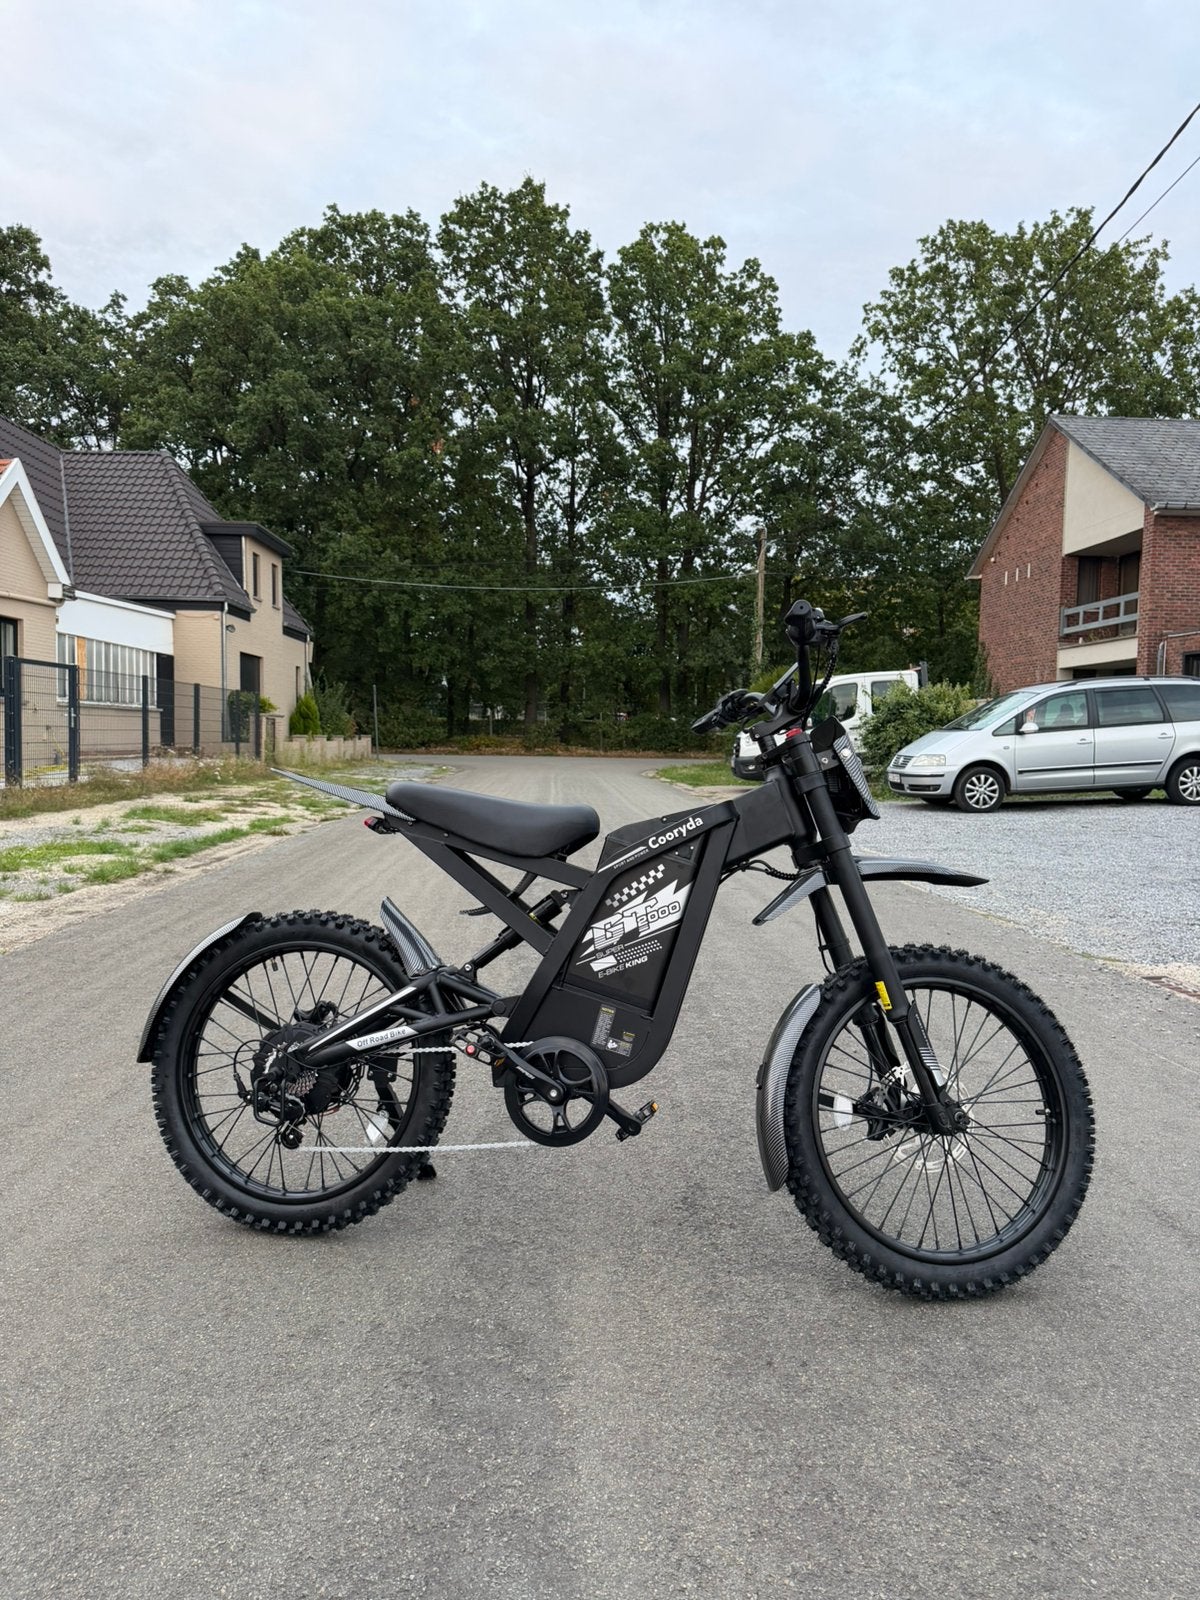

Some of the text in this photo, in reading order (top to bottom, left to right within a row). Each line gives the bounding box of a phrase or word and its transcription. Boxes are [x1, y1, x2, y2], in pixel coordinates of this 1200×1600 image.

[648, 817, 704, 849] Cooryda
[596, 944, 625, 959] SUPER
[598, 955, 648, 979] E-BIKE KING
[357, 1028, 406, 1048] Off Road Bike
